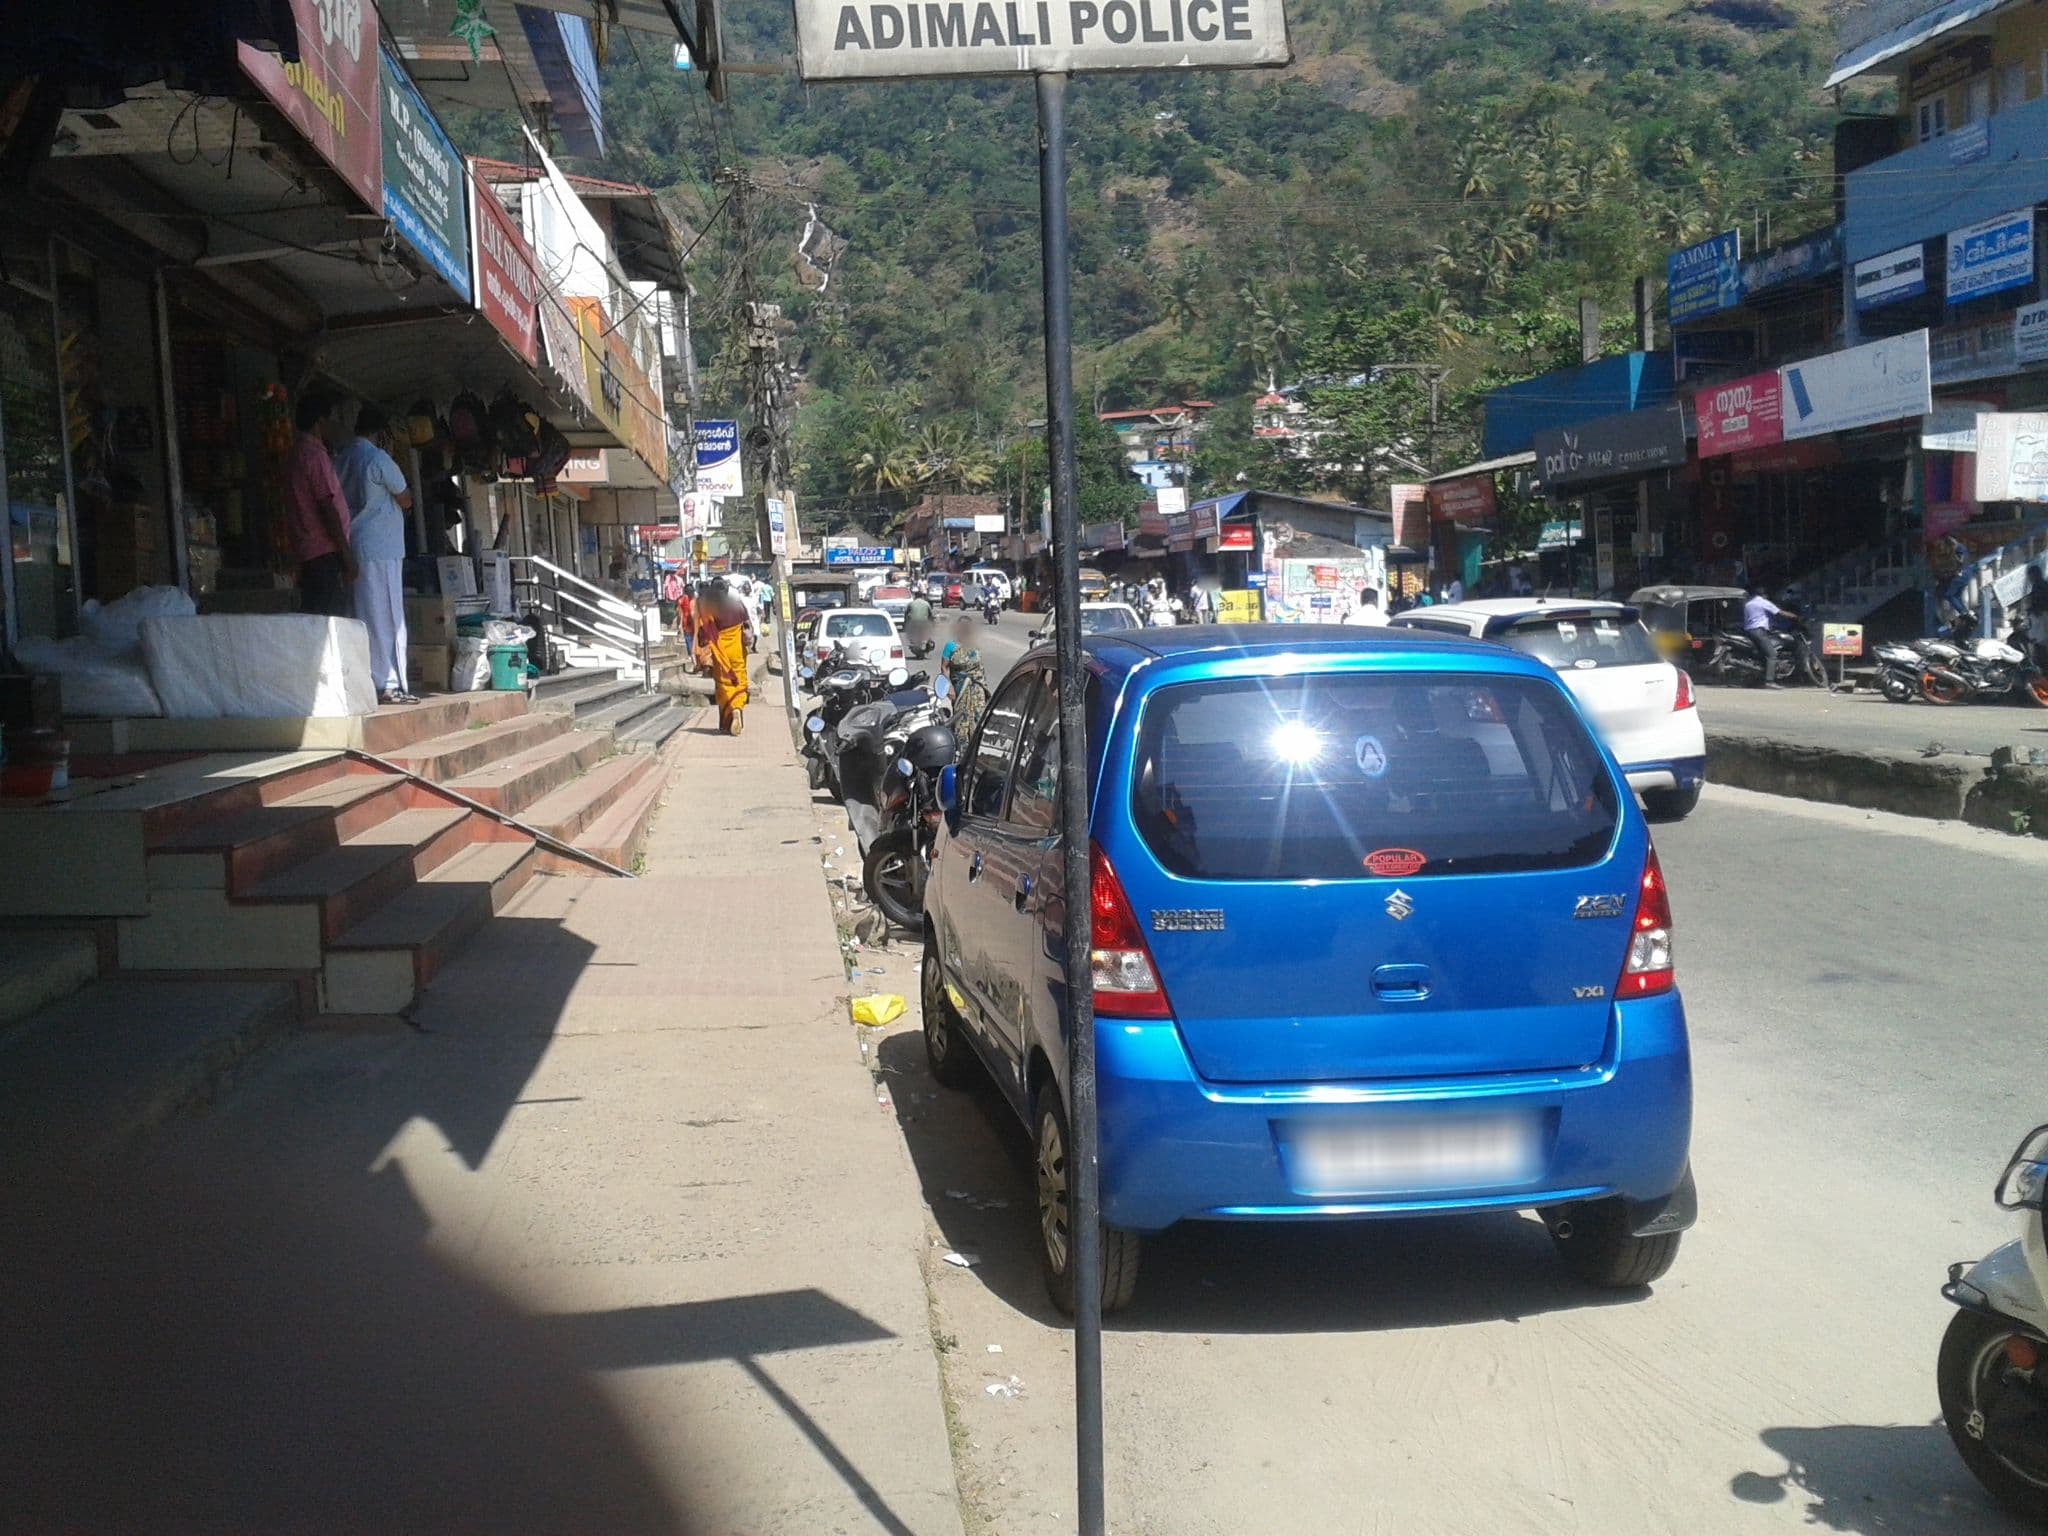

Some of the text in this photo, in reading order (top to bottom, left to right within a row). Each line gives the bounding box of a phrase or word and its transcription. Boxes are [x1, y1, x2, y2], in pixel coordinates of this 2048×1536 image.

[834, 0, 1252, 51] ADIMALI POLICE
[1372, 854, 1417, 863] POPULAR
[1575, 893, 1627, 910] ZEN
